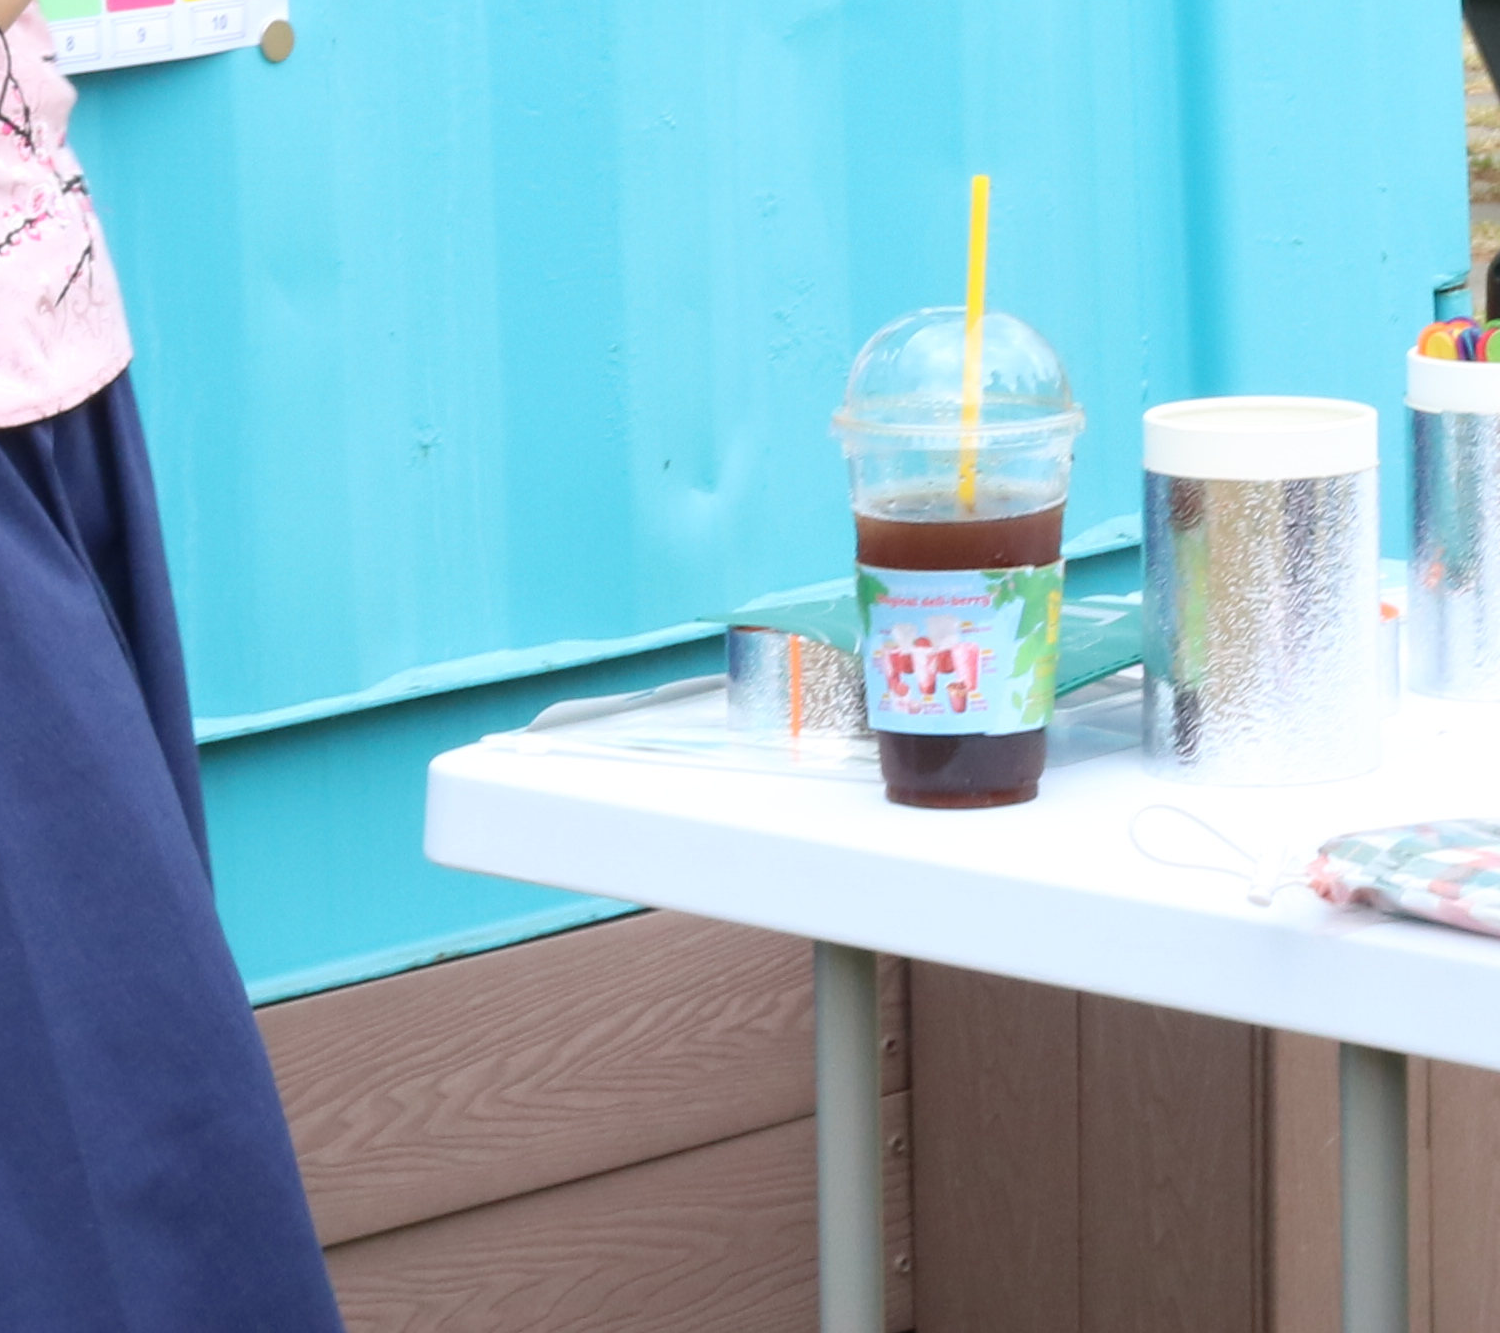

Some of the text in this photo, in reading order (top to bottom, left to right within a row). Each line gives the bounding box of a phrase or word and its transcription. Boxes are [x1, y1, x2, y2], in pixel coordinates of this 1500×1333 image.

[64, 35, 75, 52] 8
[136, 27, 147, 43] 9
[211, 14, 230, 32] 10
